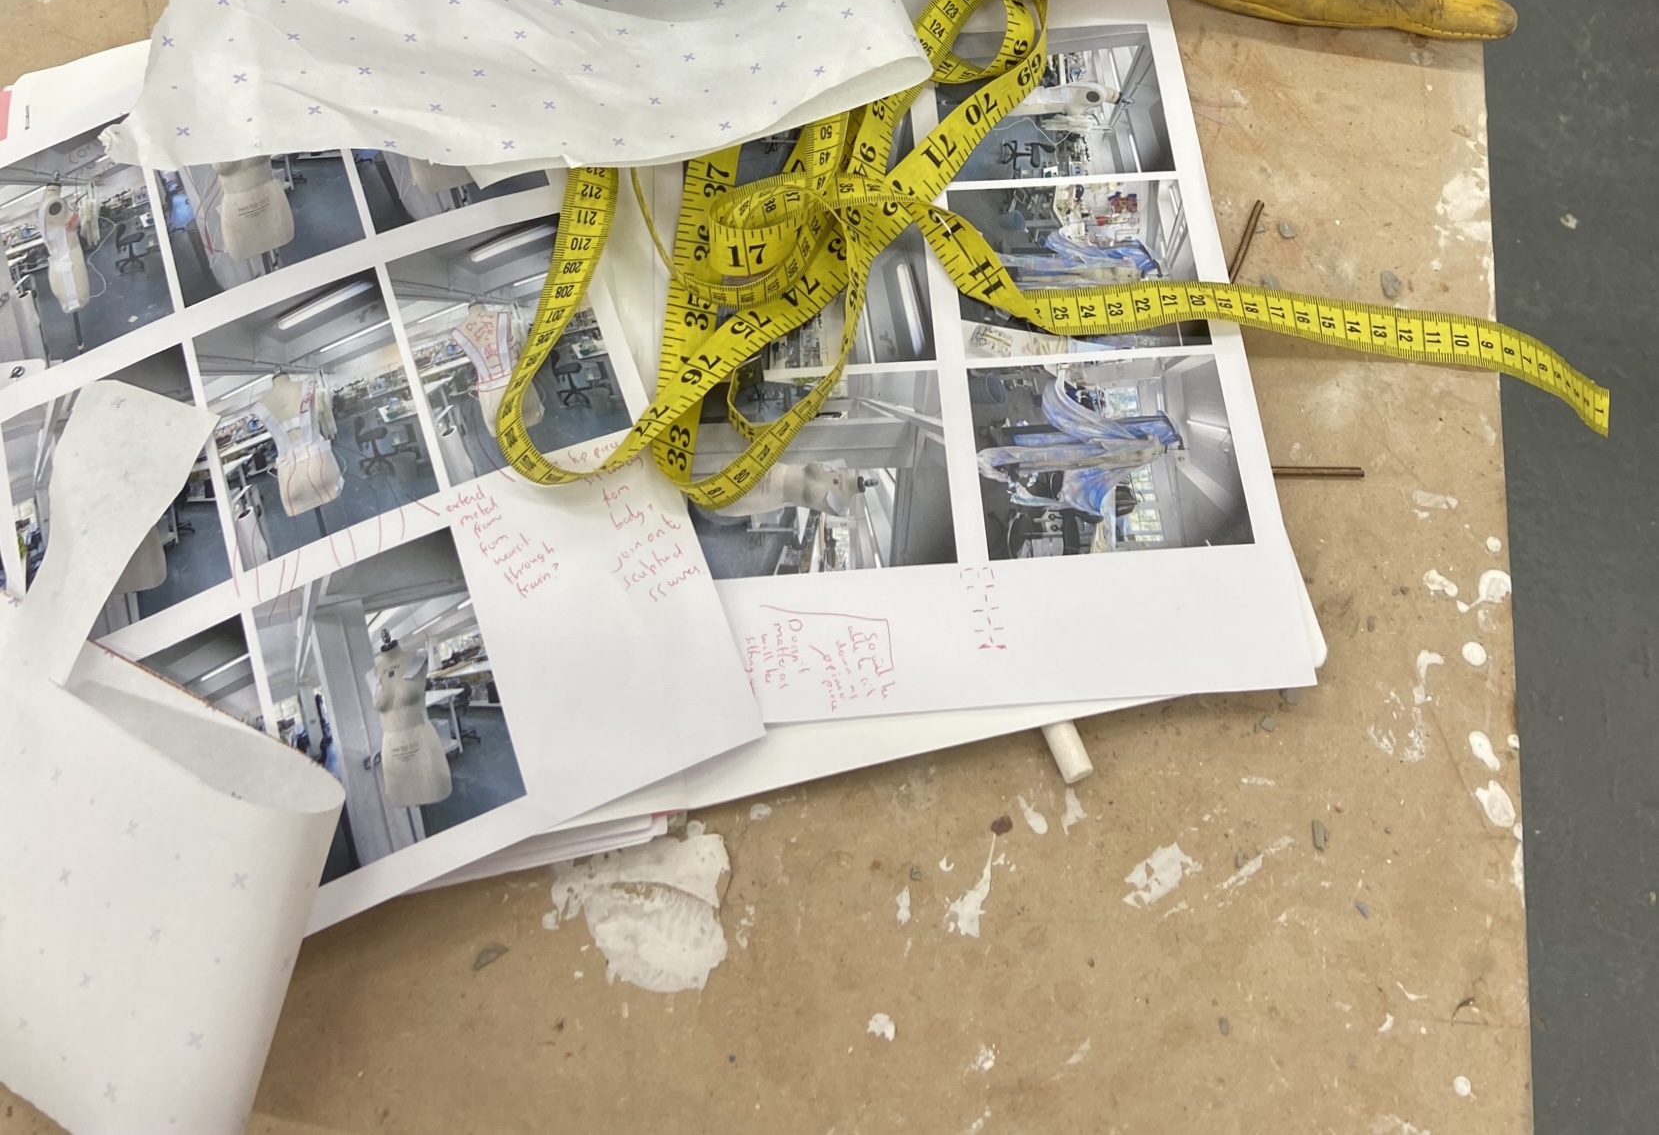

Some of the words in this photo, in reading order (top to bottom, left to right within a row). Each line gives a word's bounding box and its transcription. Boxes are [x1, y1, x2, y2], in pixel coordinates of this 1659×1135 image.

[943, 0, 959, 19] 123
[929, 19, 946, 38] 124
[936, 60, 954, 75] 114
[1017, 53, 1041, 86] 69
[965, 92, 998, 126] 70
[820, 125, 833, 140] 50
[819, 151, 830, 165] 49
[853, 142, 877, 178] 94
[921, 134, 957, 169] 71
[703, 161, 730, 198] 37
[839, 183, 854, 194] 35
[581, 183, 603, 200] 212
[576, 209, 598, 226] 211
[570, 237, 592, 251] 210
[727, 243, 767, 267] 17
[563, 261, 583, 275] 209
[968, 256, 1007, 300] 11
[555, 284, 575, 299] 208
[781, 274, 821, 307] 74
[546, 308, 566, 324] 207
[730, 310, 772, 340] 75
[1053, 307, 1069, 320] 25
[1080, 305, 1096, 319] 24
[1108, 302, 1123, 316] 23
[1135, 297, 1150, 313] 22
[1162, 294, 1178, 307] 21
[1190, 294, 1206, 307] 20
[1217, 298, 1233, 310] 19
[1243, 301, 1259, 314] 18
[1269, 305, 1285, 319] 17
[1295, 310, 1310, 324] 16
[1321, 315, 1336, 329] 15
[1347, 320, 1361, 334] 14
[1373, 324, 1387, 339] 13
[1399, 328, 1413, 343] 12
[1426, 331, 1441, 344] 11
[1454, 333, 1470, 347] 10
[1481, 340, 1494, 349] 9
[1503, 347, 1515, 356] 8
[1522, 354, 1532, 364] 7
[1538, 363, 1548, 372] 6
[1554, 371, 1562, 380] 5
[1595, 407, 1604, 415] 1
[681, 354, 722, 386] 76
[568, 451, 587, 464] hip
[667, 424, 691, 471] 33
[733, 468, 750, 484] 80
[446, 484, 486, 512] extend
[707, 486, 725, 499] 81
[460, 496, 499, 526] metal
[647, 528, 665, 543] on
[504, 541, 555, 585] through
[761, 633, 774, 662] will
